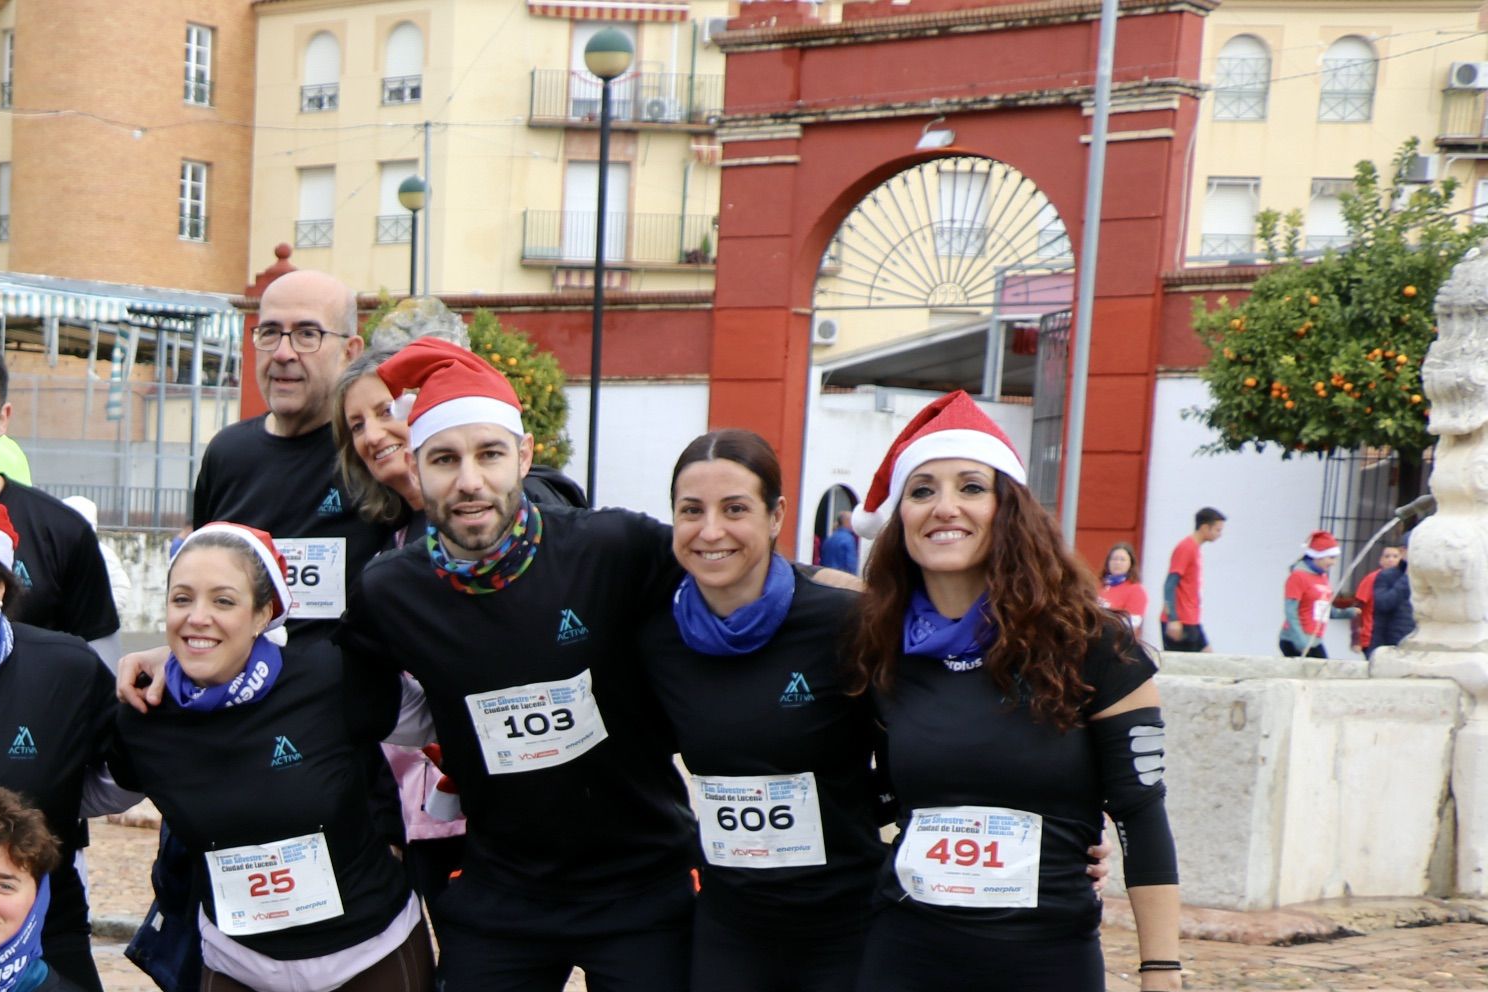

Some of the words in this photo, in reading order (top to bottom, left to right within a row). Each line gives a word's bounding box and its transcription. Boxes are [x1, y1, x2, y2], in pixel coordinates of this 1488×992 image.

[557, 627, 589, 641] ACTIVA
[780, 694, 816, 703] ACTIVA
[484, 704, 510, 715] Ciudad
[511, 703, 519, 711] de
[521, 701, 547, 710] Lucena
[504, 708, 575, 739] 103
[8, 746, 38, 754] ACTIVA
[271, 753, 303, 767] ACTIVA
[704, 793, 726, 801] Ciudad
[727, 793, 736, 801] de
[737, 794, 763, 802] Lucena
[717, 805, 795, 832] 606
[932, 816, 964, 825] Silvestre
[941, 824, 950, 832] de
[952, 824, 980, 834] Lucena
[776, 845, 811, 853] enerplus
[925, 838, 1005, 868] 491
[221, 864, 244, 873] Ciudad
[245, 862, 253, 870] de
[254, 860, 278, 869] Lucena
[248, 868, 296, 897] 25
[983, 886, 1023, 894] enerplus
[295, 899, 327, 912] enerplus
